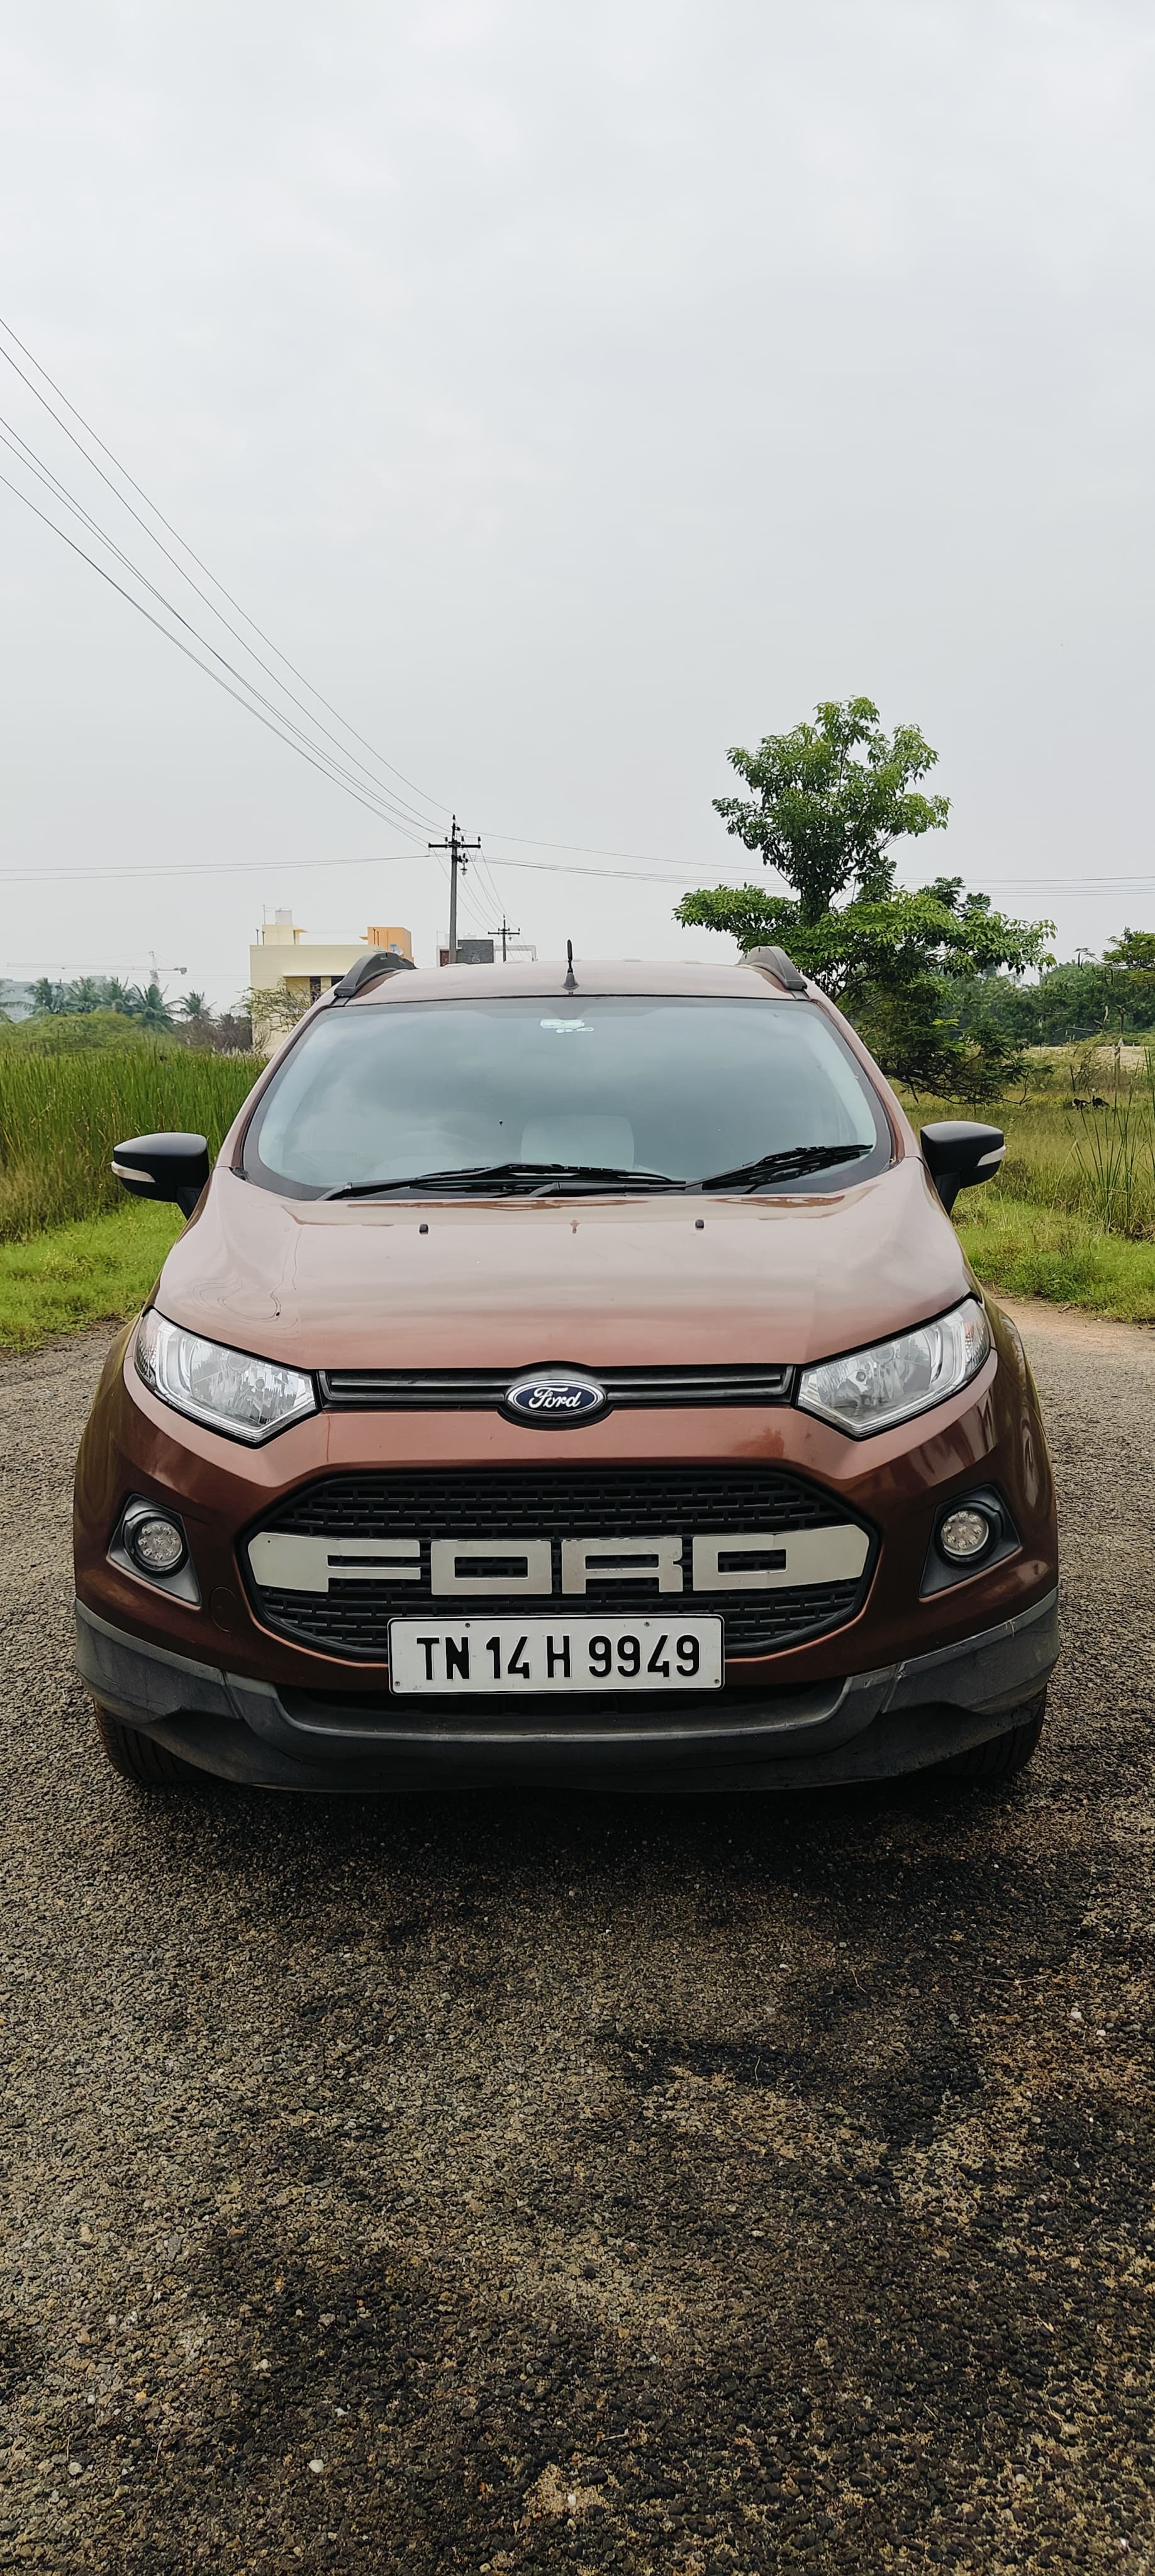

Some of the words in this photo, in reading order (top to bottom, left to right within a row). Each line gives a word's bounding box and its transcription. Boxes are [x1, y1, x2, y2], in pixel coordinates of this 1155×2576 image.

[528, 1387, 581, 1408] Ford
[248, 1524, 870, 1595] FORD
[416, 1636, 469, 1680] TN
[486, 1636, 530, 1679] 14
[547, 1635, 571, 1678] H
[588, 1635, 700, 1678] 9949
